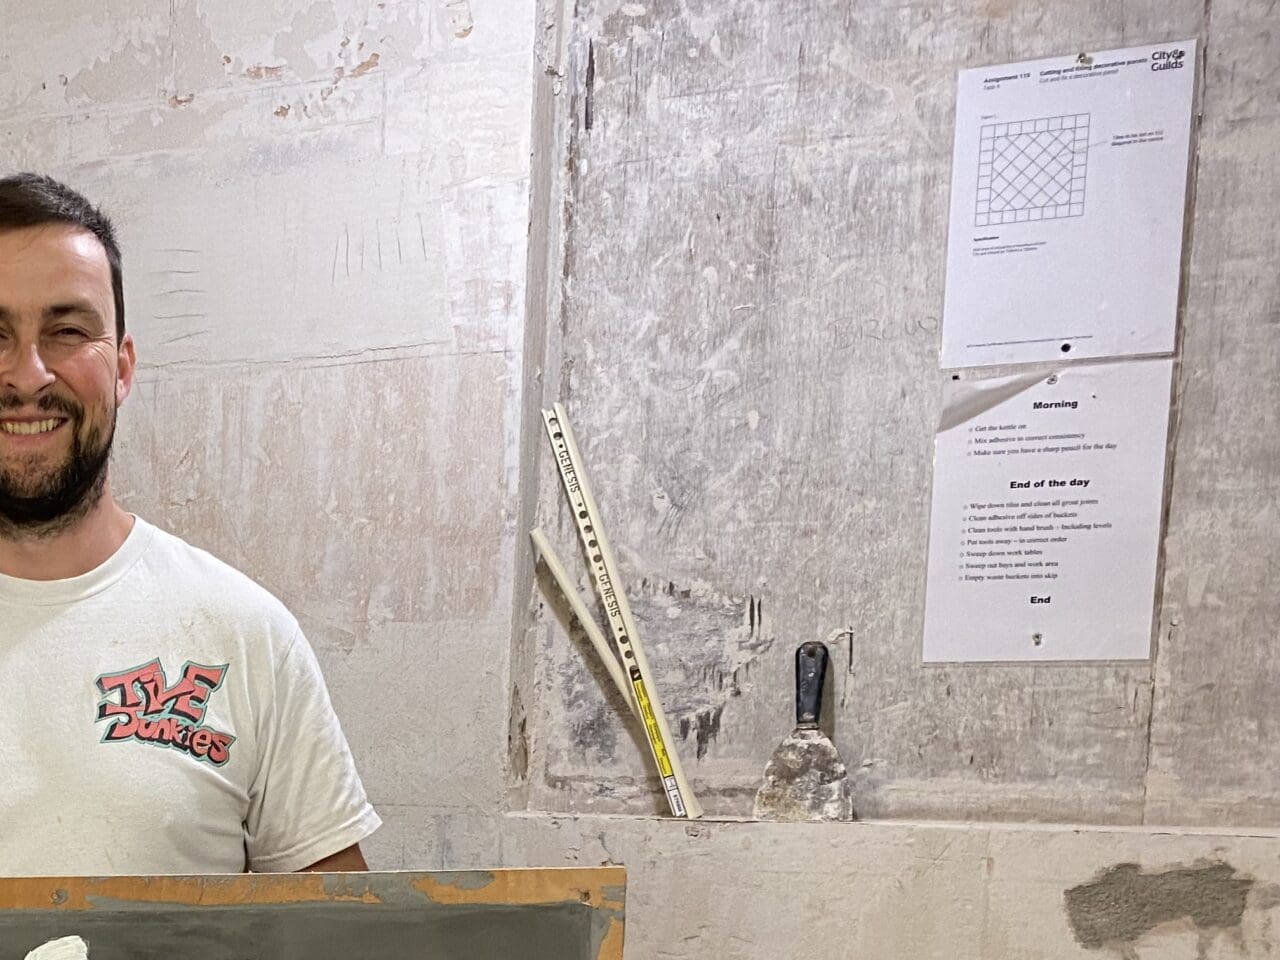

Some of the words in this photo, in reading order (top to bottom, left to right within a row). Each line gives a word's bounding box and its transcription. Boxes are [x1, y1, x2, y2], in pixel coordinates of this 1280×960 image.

[1151, 61, 1184, 72] Guilds
[1033, 400, 1078, 410] Morning
[973, 449, 991, 457] Make
[1007, 448, 1019, 456] you
[1042, 445, 1060, 454] sharp
[1061, 444, 1081, 453] pencil
[1082, 443, 1092, 451] for
[1105, 442, 1117, 451] day
[558, 450, 581, 493] GENESIS
[1010, 480, 1031, 489] End
[1033, 479, 1046, 488] of
[1048, 479, 1067, 487] the
[1069, 478, 1090, 488] day
[970, 503, 986, 511] Wipe
[1053, 511, 1078, 519] buckets
[1004, 525, 1018, 533] with
[1019, 524, 1035, 532] hand
[966, 550, 987, 558] Sweep
[965, 574, 985, 582] Empty
[1044, 572, 1058, 580] skip
[598, 573, 621, 618] GENESIS
[1030, 595, 1051, 604] End
[95, 703, 236, 767] Junkies
